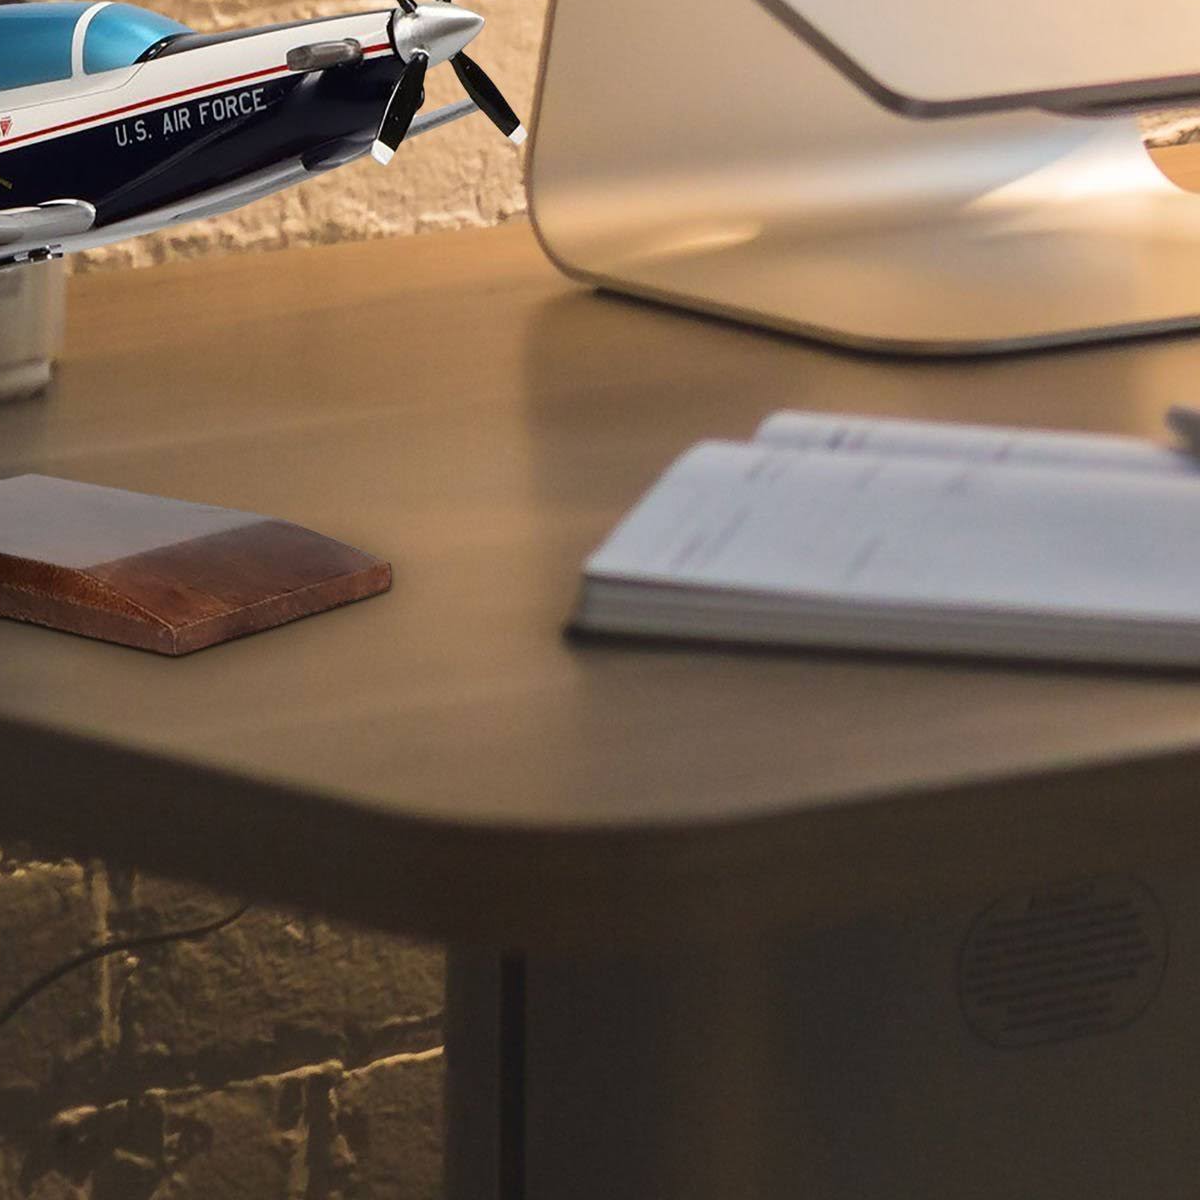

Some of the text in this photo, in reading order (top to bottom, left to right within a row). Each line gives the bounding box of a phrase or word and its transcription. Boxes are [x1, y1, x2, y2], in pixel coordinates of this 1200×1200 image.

[115, 88, 268, 147] U.S. AIR FORCE
